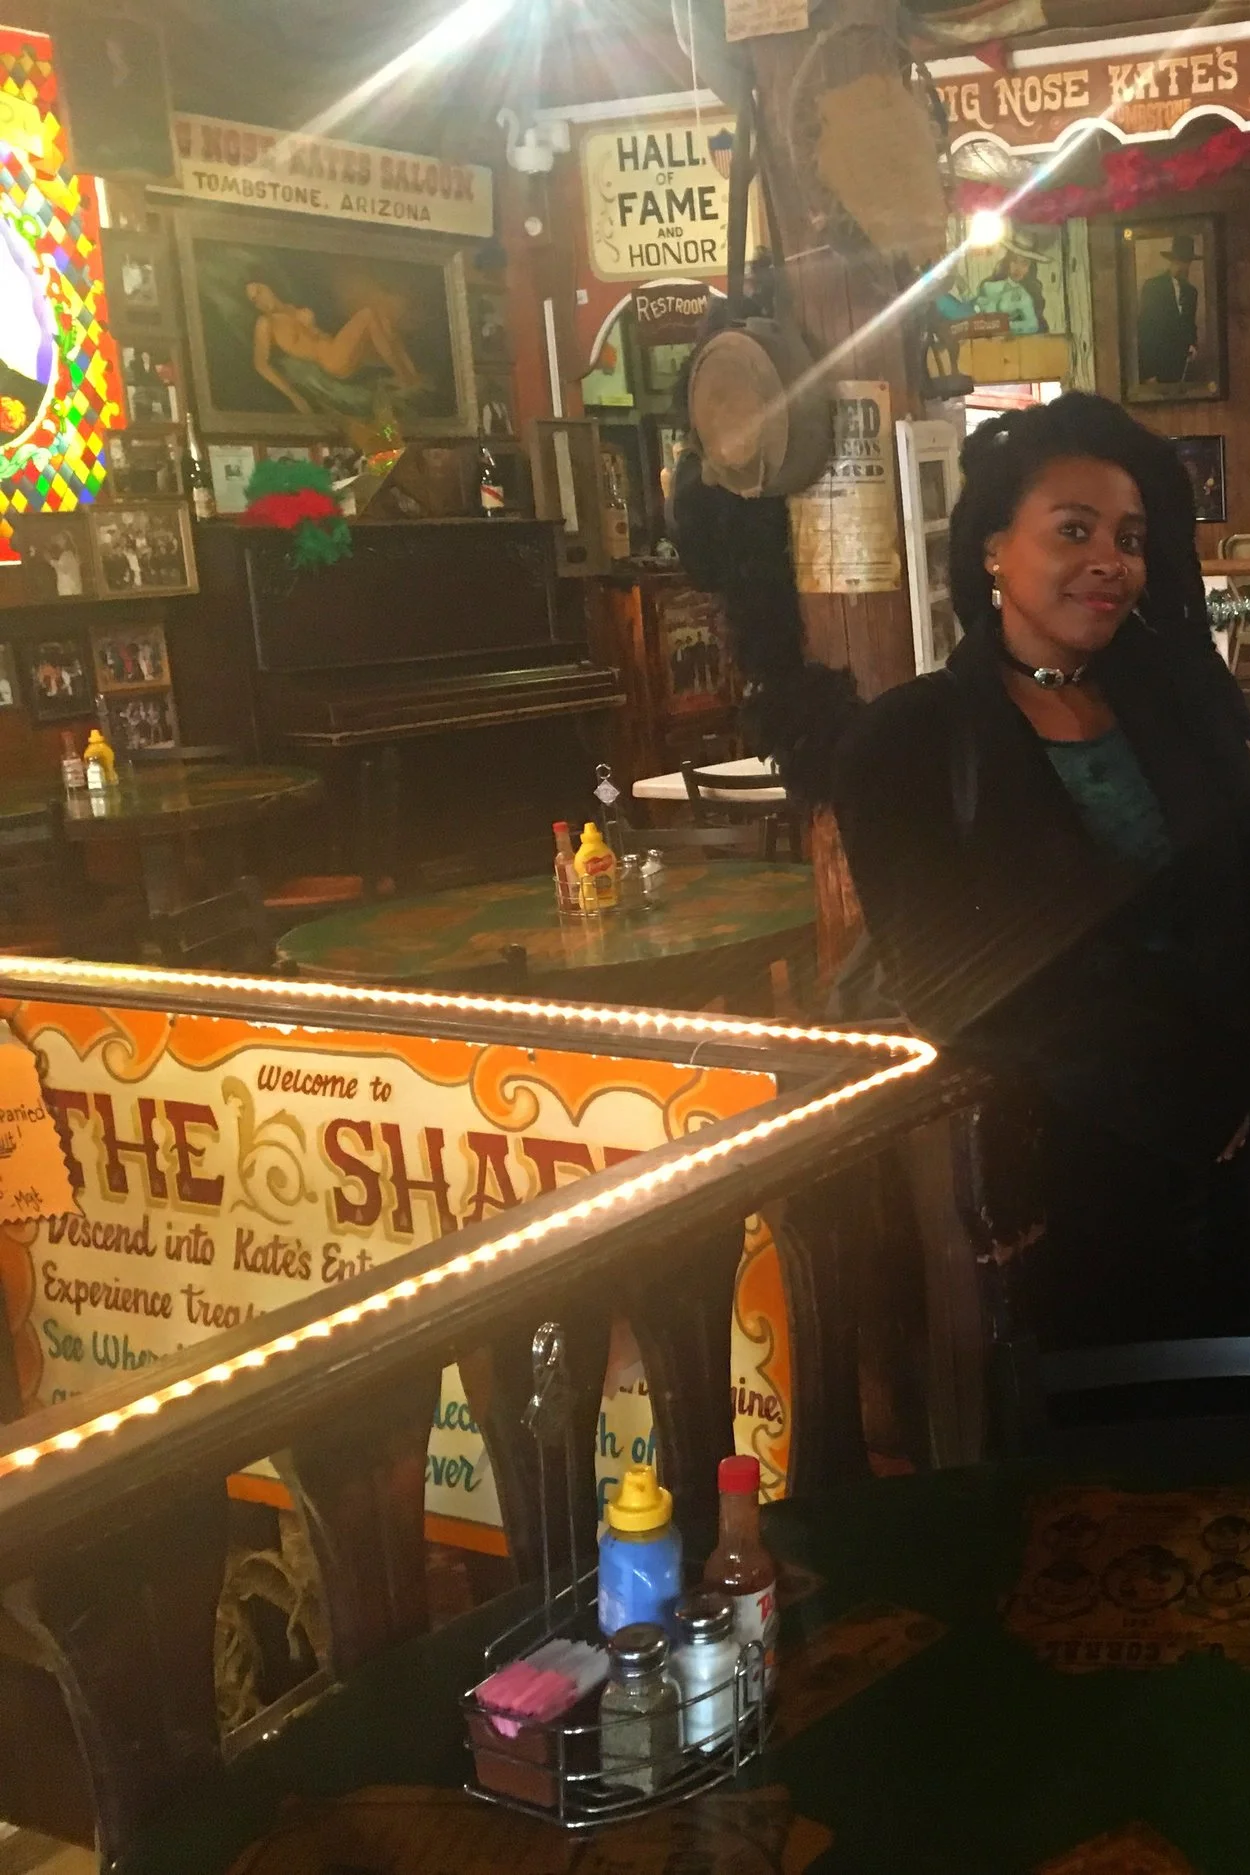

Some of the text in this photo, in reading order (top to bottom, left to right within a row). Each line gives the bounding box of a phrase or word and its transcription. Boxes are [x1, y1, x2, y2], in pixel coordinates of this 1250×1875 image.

[997, 70, 1090, 127] NOSE
[1108, 46, 1239, 102] KATE'S
[655, 171, 675, 186] OF
[339, 193, 432, 222] ARIZONA
[617, 185, 719, 227] FAME
[628, 239, 717, 268] HONOR
[657, 226, 684, 239] AND
[257, 1064, 393, 1103] Welcome to
[42, 1086, 225, 1206] THE
[164, 1221, 217, 1267] into
[232, 1226, 312, 1282] Kate's
[320, 1241, 377, 1285] Ent
[41, 1260, 174, 1316] Experience
[42, 1318, 85, 1368] See
